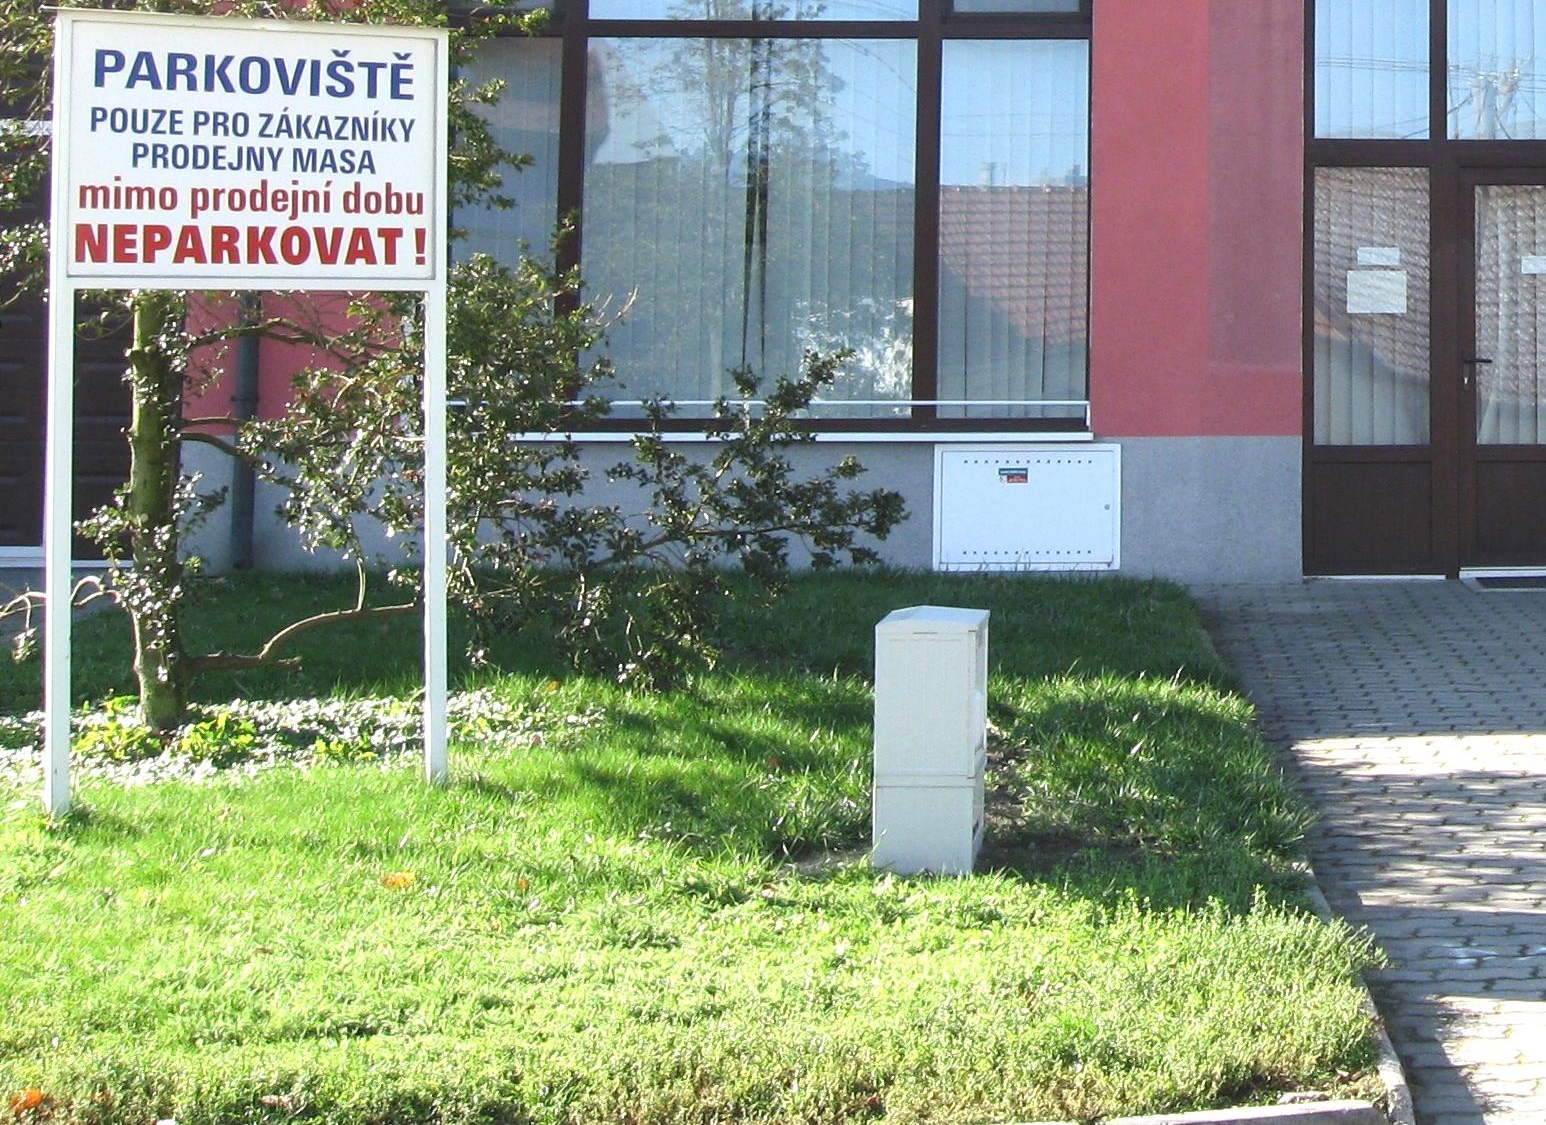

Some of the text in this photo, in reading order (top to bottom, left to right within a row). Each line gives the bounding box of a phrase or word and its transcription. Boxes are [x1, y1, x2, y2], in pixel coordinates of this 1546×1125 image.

[94, 49, 415, 101] PARKOVIŠTĚ
[90, 107, 416, 142] POUZE PRO ZÁKAZNÍKY
[132, 144, 377, 174] PRODEJNY MASA
[79, 176, 424, 220] mimo prodejní dobu
